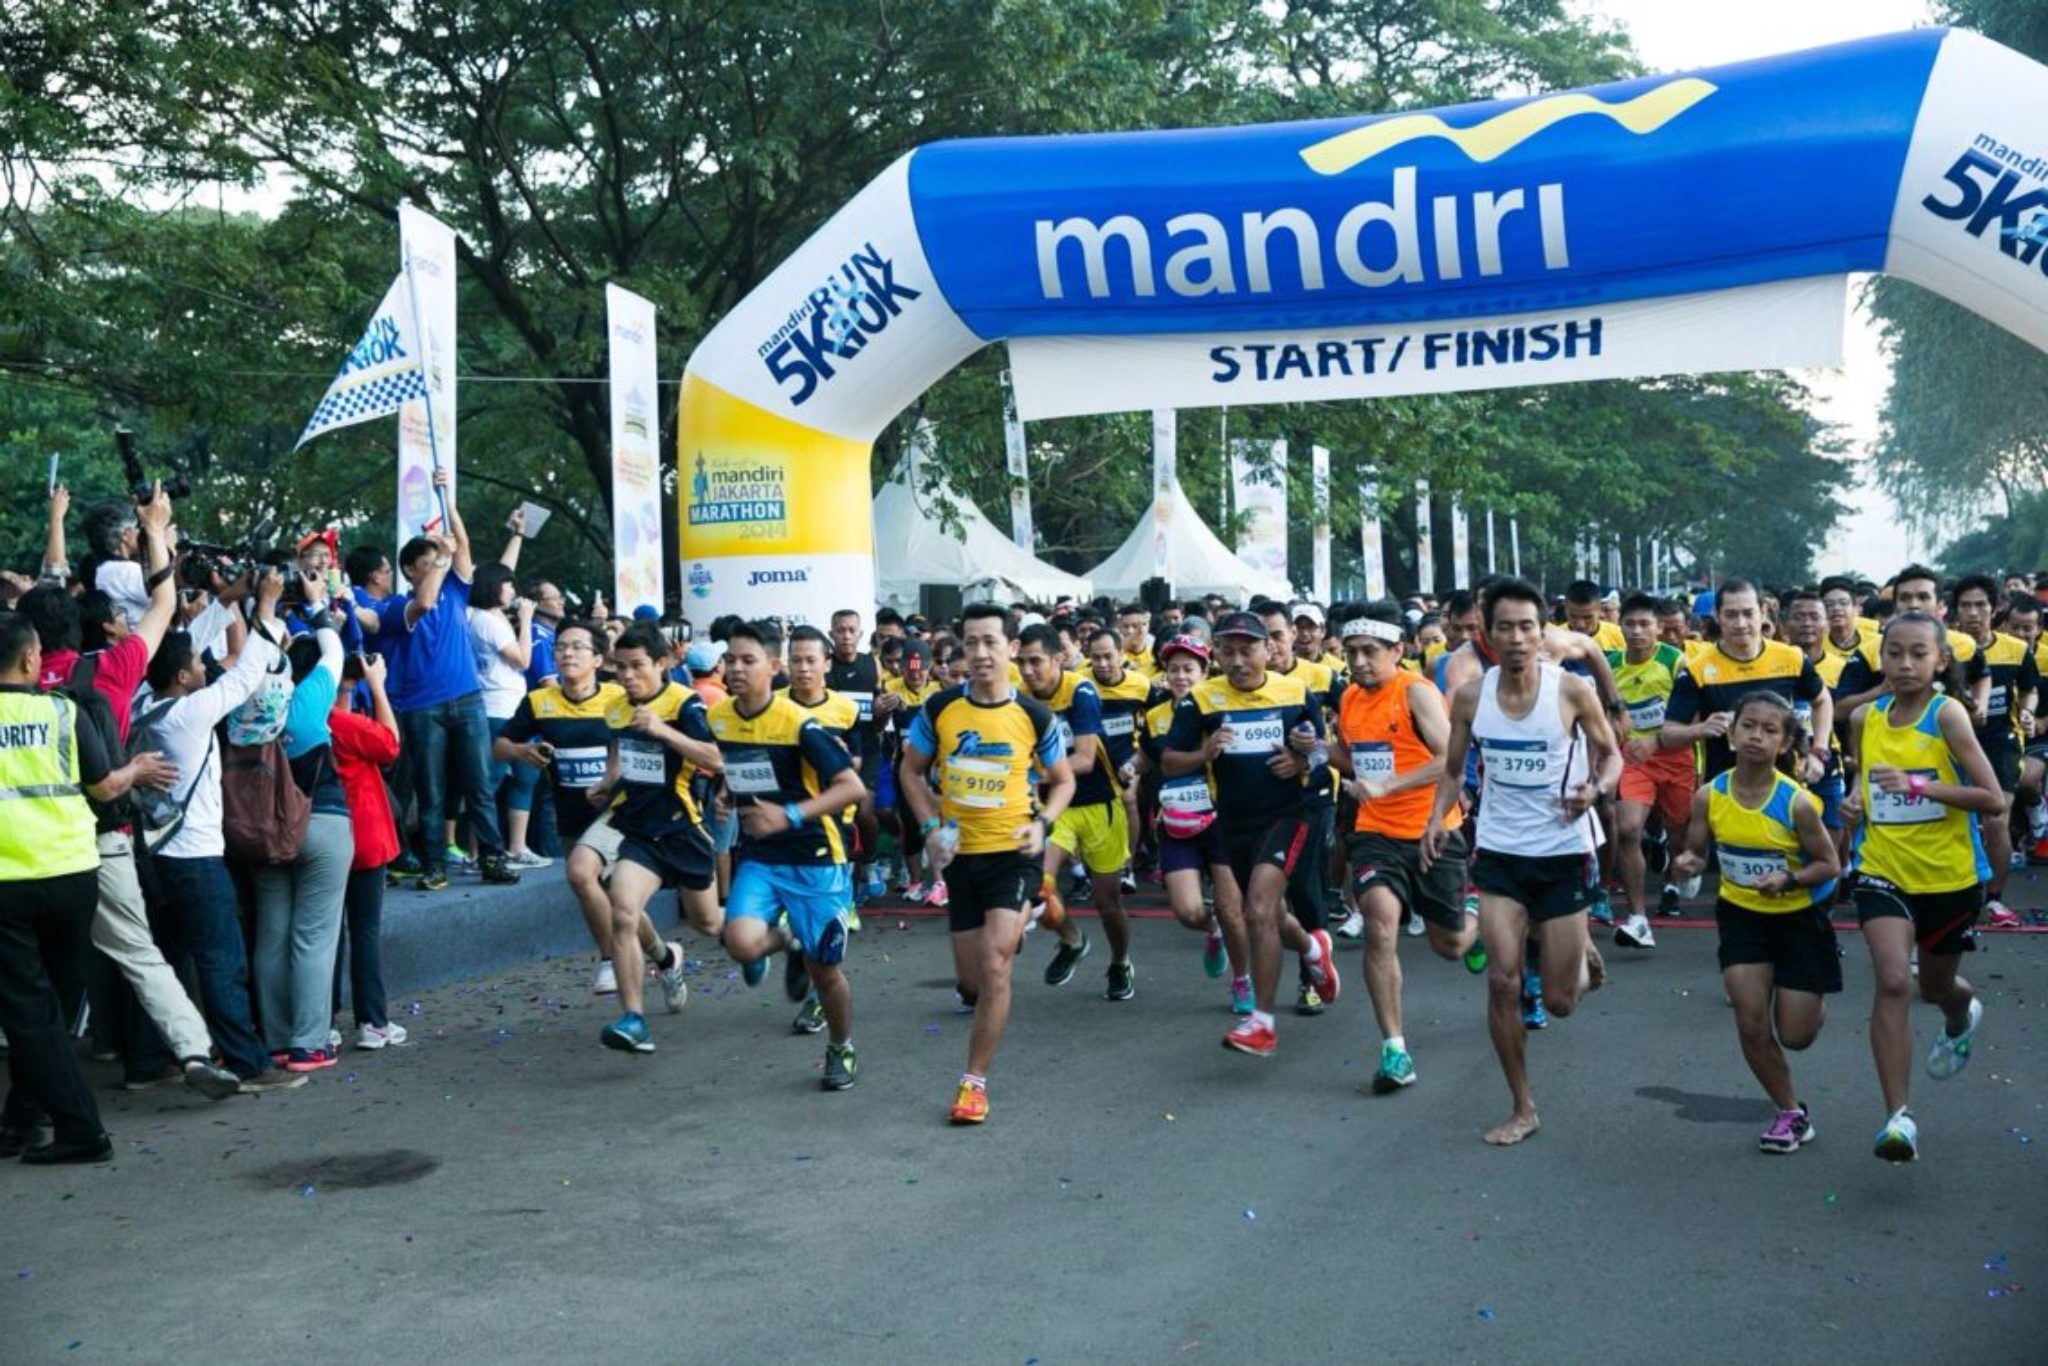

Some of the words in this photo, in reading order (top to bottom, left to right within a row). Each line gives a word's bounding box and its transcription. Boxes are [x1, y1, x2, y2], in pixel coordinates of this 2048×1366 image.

[1035, 166, 1569, 298] mandiri
[757, 300, 814, 357] mandiri
[808, 242, 886, 320] RUN
[712, 466, 784, 484] mandiri
[712, 483, 784, 501] JAKARTA
[690, 503, 781, 521] MARATHON
[739, 523, 787, 540] 2014
[1244, 726, 1282, 741] 6960
[573, 762, 607, 775] 1863
[632, 756, 663, 771] 2029
[1363, 758, 1392, 771] 5202
[1503, 757, 1547, 772] 3799
[966, 776, 1006, 792] 9109
